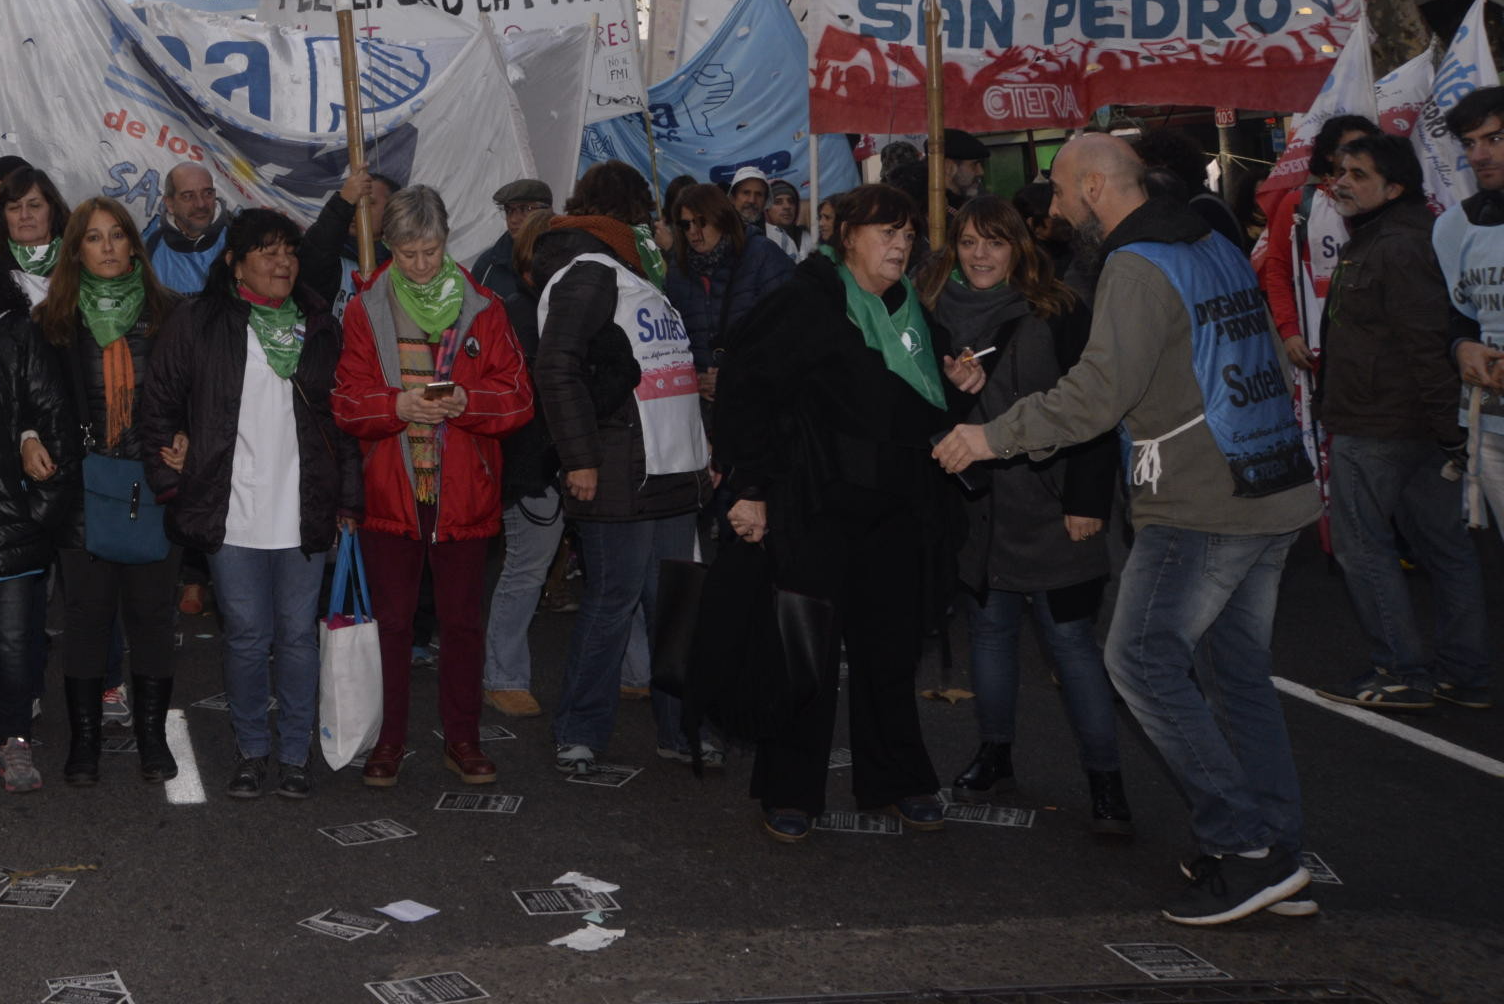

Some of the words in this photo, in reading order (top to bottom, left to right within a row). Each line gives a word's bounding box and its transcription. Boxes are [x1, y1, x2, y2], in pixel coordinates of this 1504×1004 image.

[983, 84, 1083, 120] CTERA
[1216, 110, 1235, 124] 103
[103, 108, 147, 140] de
[155, 124, 205, 162] los
